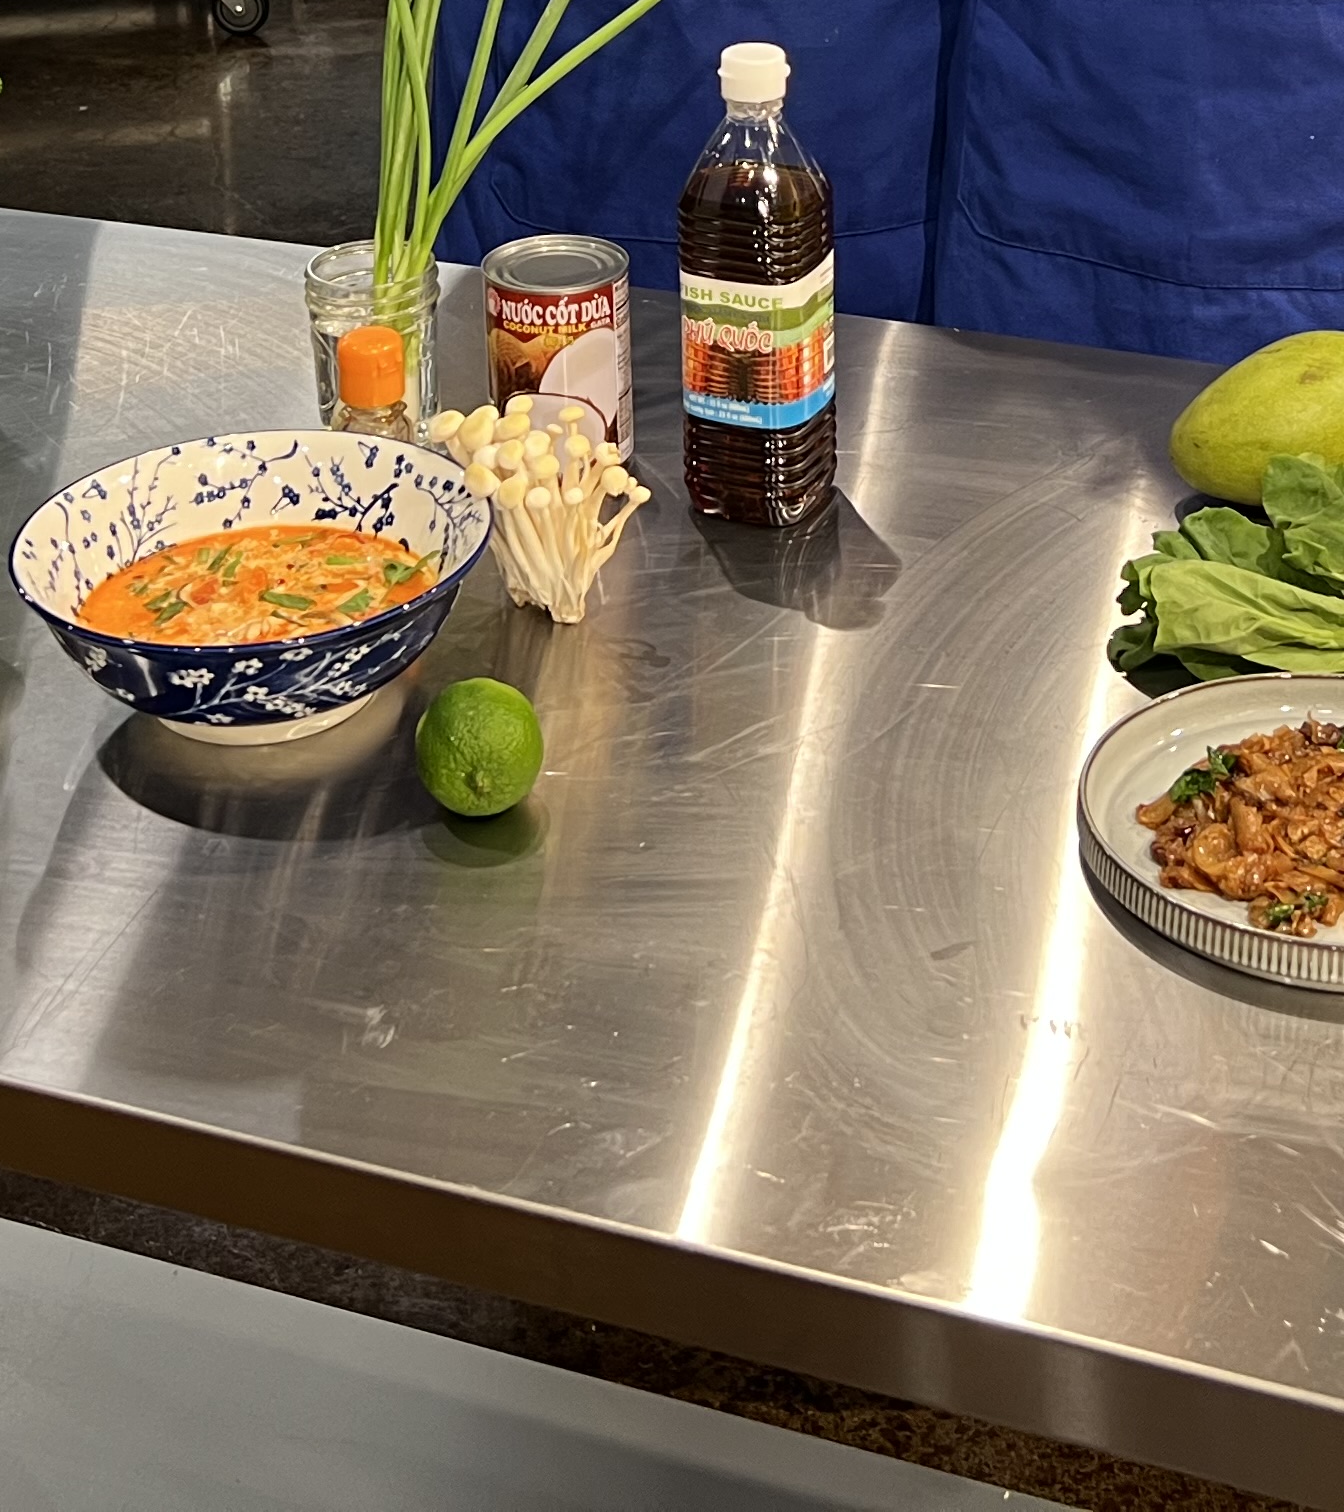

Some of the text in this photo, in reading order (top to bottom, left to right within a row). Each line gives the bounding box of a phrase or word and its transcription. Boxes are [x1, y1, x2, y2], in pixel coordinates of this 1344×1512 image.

[680, 283, 783, 310] ISH SAUCE
[501, 298, 543, 325] NƯỚC
[545, 296, 579, 326] CỐT
[503, 320, 555, 335] COCONUT
[558, 322, 587, 334] MILK
[717, 320, 774, 354] QUỐC
